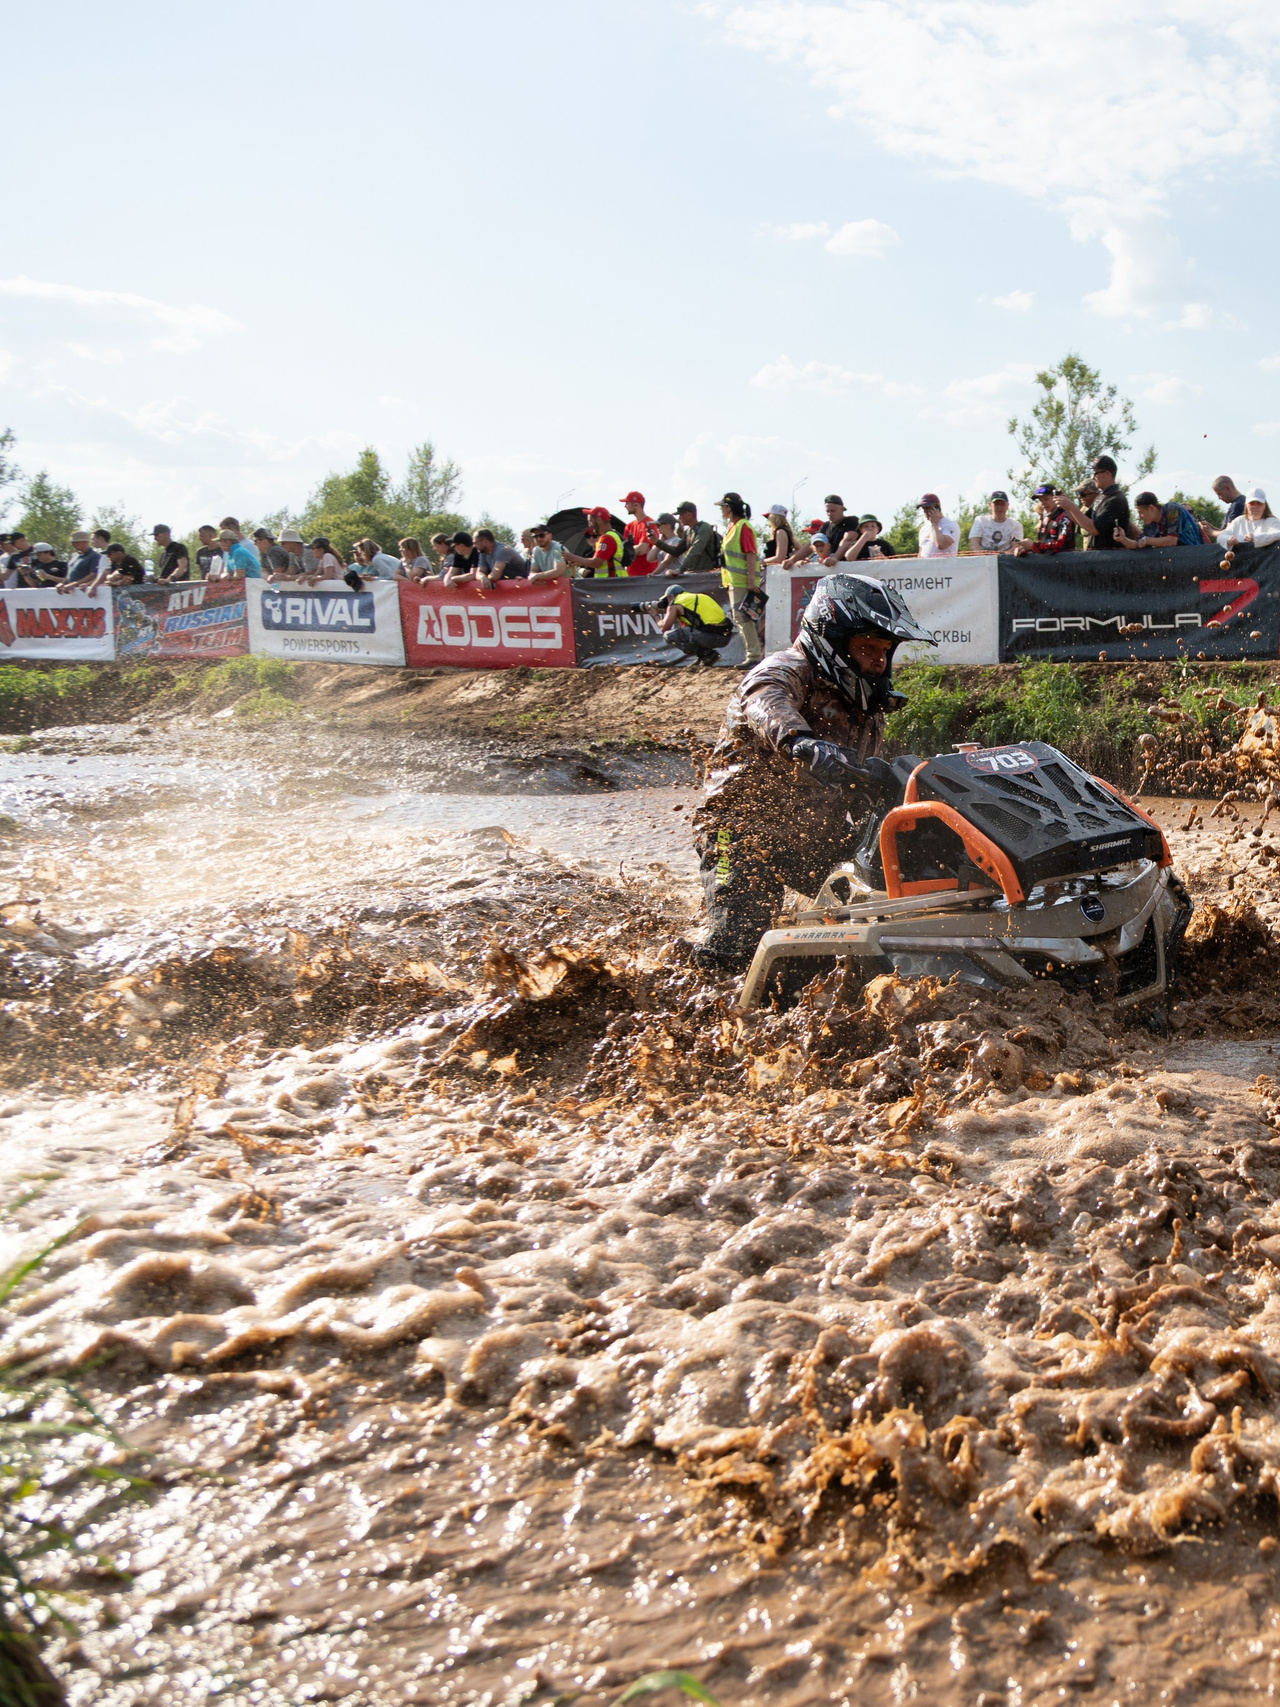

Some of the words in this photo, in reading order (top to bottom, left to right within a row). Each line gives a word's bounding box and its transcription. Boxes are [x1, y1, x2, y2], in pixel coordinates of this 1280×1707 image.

[167, 586, 207, 612] ATV
[285, 598, 371, 626] RIVAL
[1012, 613, 1202, 632] FORMULA
[1199, 578, 1260, 628] 7
[16, 608, 107, 638] MAXXIS
[163, 602, 247, 633] RUSSIAN
[417, 605, 563, 649] AODES
[598, 613, 668, 637] FINN
[191, 625, 245, 651] TEAM
[282, 638, 361, 653] POWERSPORTS
[979, 751, 1036, 772] 703
[1089, 838, 1132, 852] SHARMAX
[793, 931, 847, 939] SHARMAX
